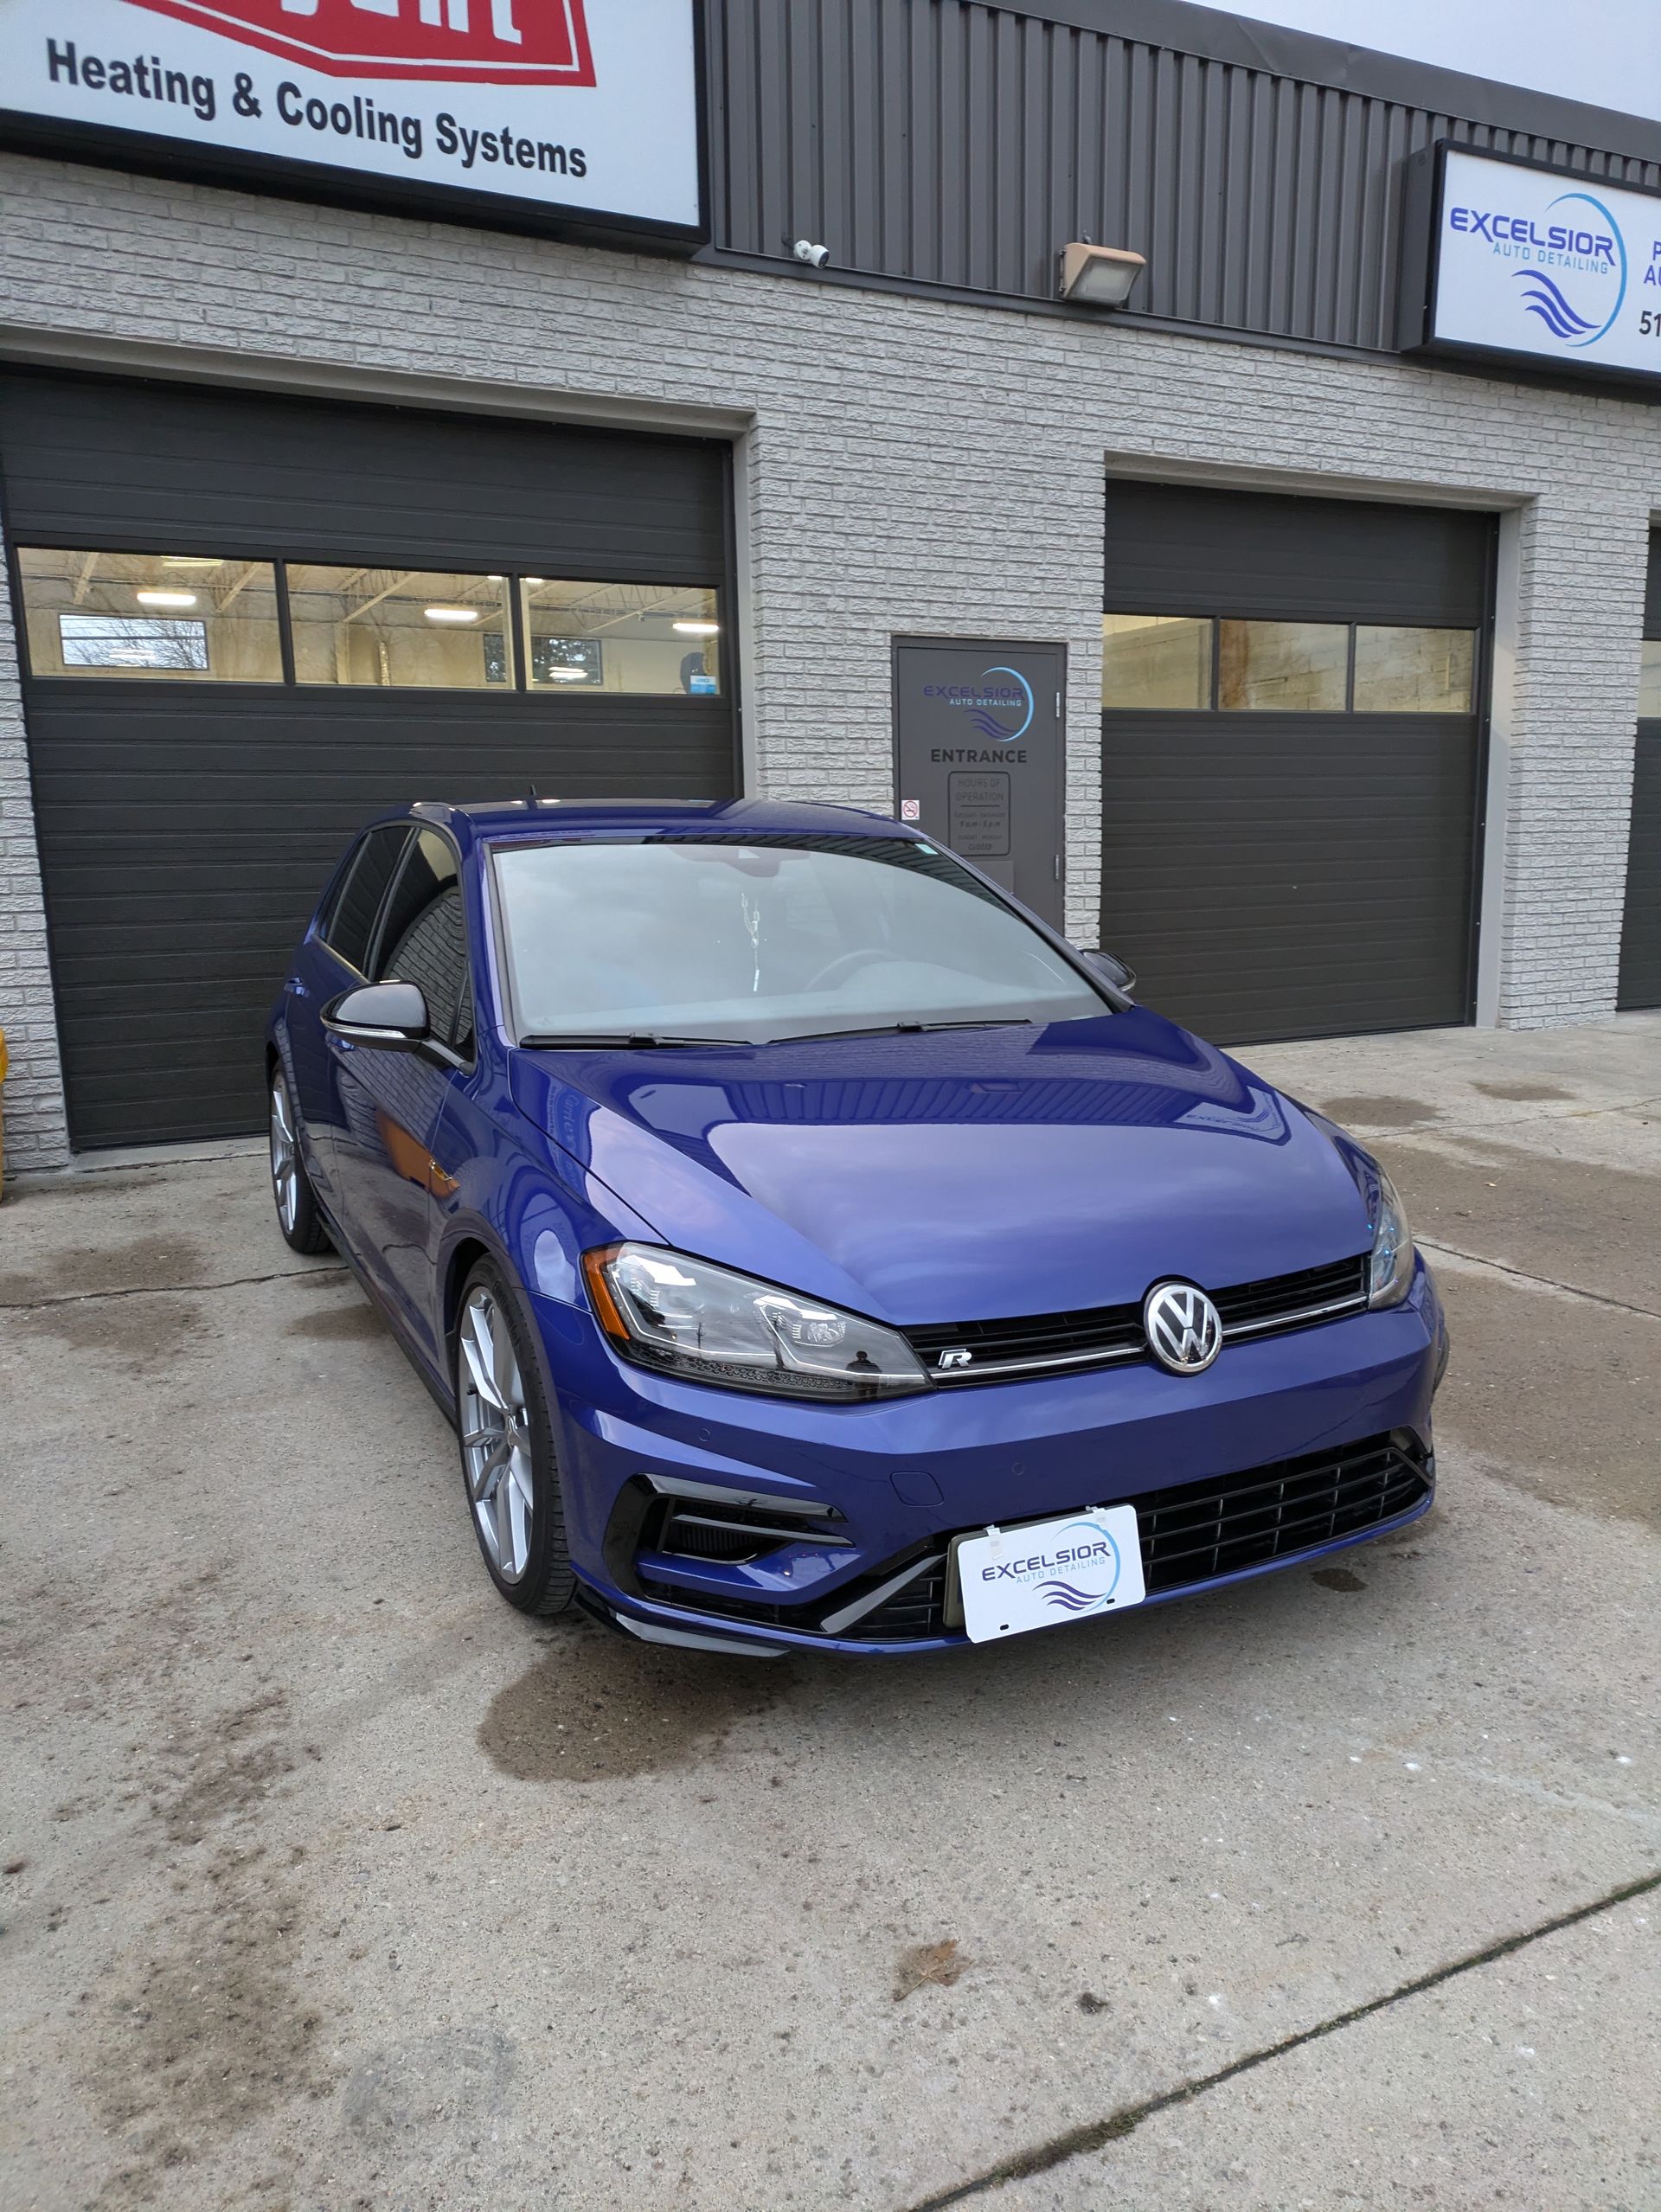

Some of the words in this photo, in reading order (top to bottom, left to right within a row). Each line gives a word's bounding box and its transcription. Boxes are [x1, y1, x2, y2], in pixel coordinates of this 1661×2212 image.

[47, 37, 216, 121] Heating
[232, 72, 263, 119] &
[276, 80, 422, 159] Cooling
[435, 112, 587, 178] Systems
[1450, 207, 1616, 266] EXCELSIOR
[1492, 242, 1530, 260] AUTO
[1537, 249, 1609, 274] DETAILING
[923, 685, 1025, 700] EXCELSIOR
[931, 748, 1028, 763] ENTRANCE
[981, 1542, 1111, 1581] EXCELSIOR
[1016, 1569, 1045, 1584] AUTO
[1049, 1556, 1106, 1576] DETAILING
